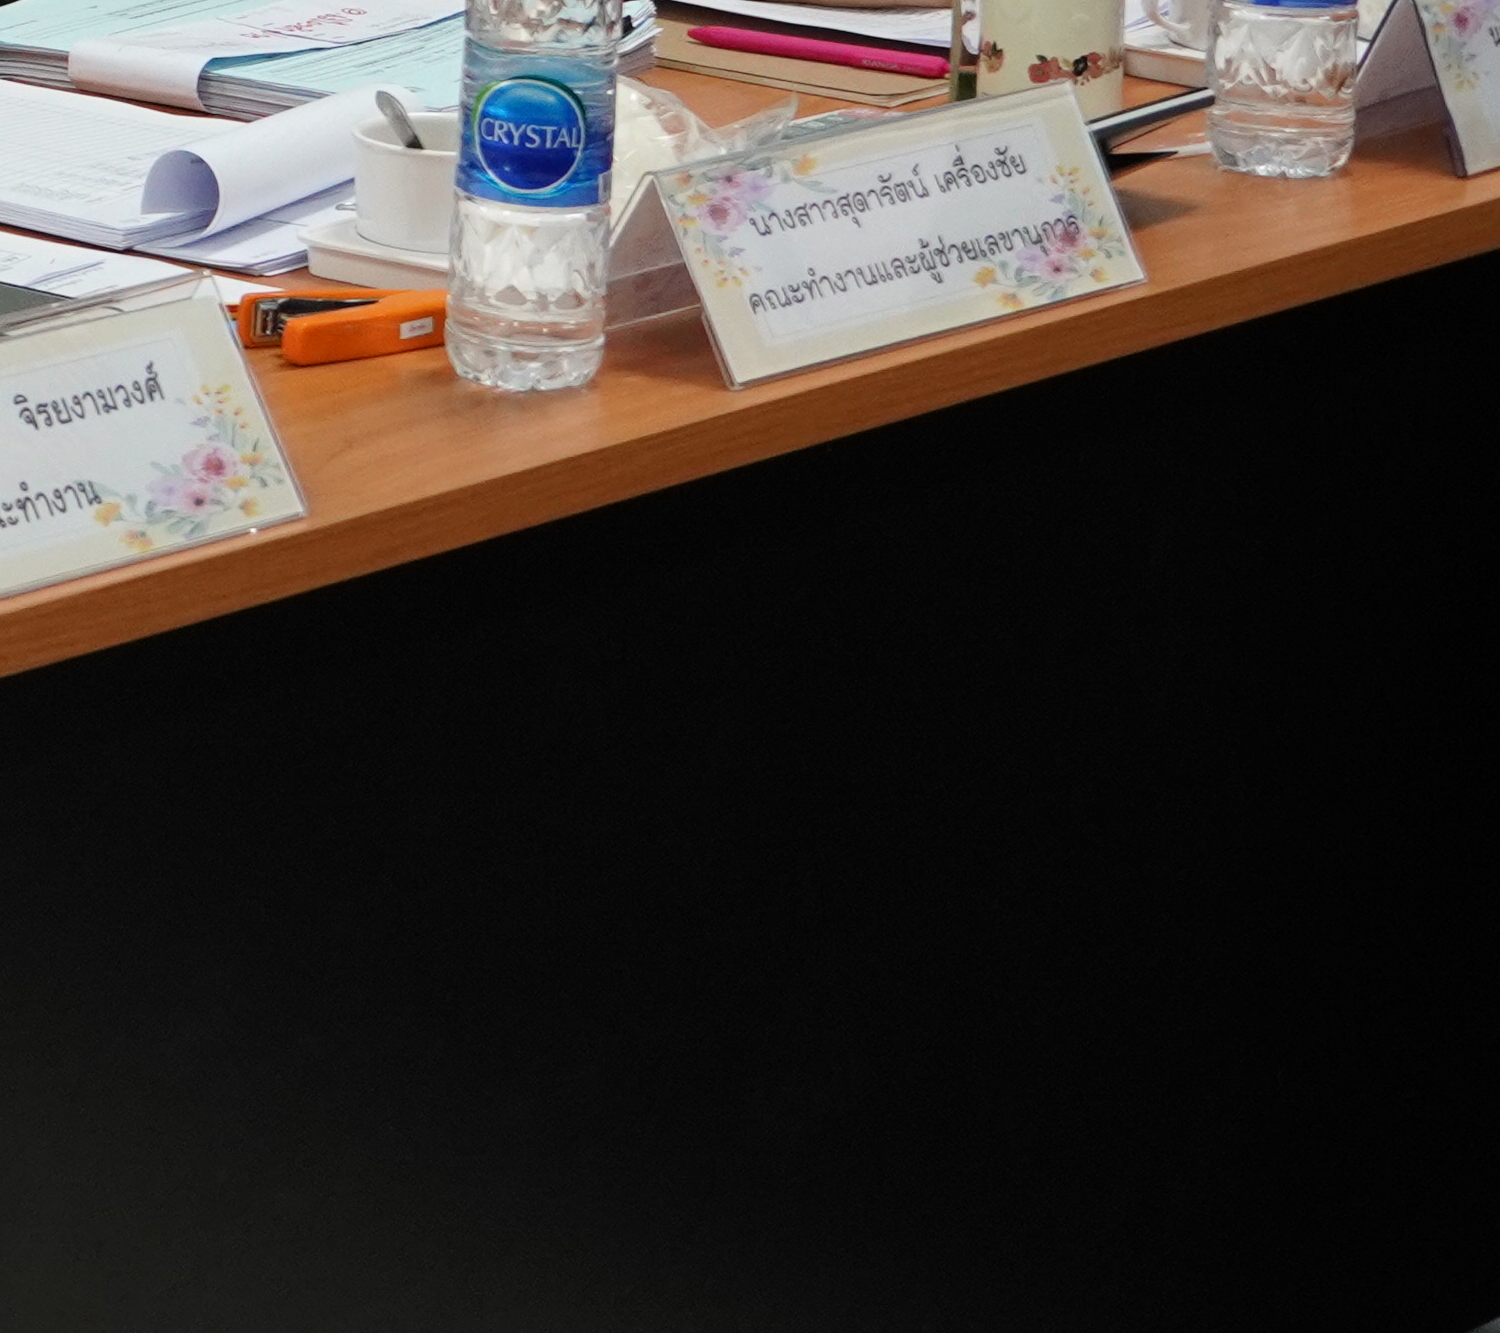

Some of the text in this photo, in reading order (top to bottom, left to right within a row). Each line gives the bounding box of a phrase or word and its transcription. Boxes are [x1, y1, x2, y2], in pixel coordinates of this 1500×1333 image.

[479, 117, 581, 149] CRYSTAL
[748, 144, 1027, 238] นางสาวสุดารัตน์ เครื่องชัย
[748, 213, 1081, 315] คณะทำงานและผู้ช่วยเลขานุการ
[12, 362, 165, 432] จิรยงามวงศ์
